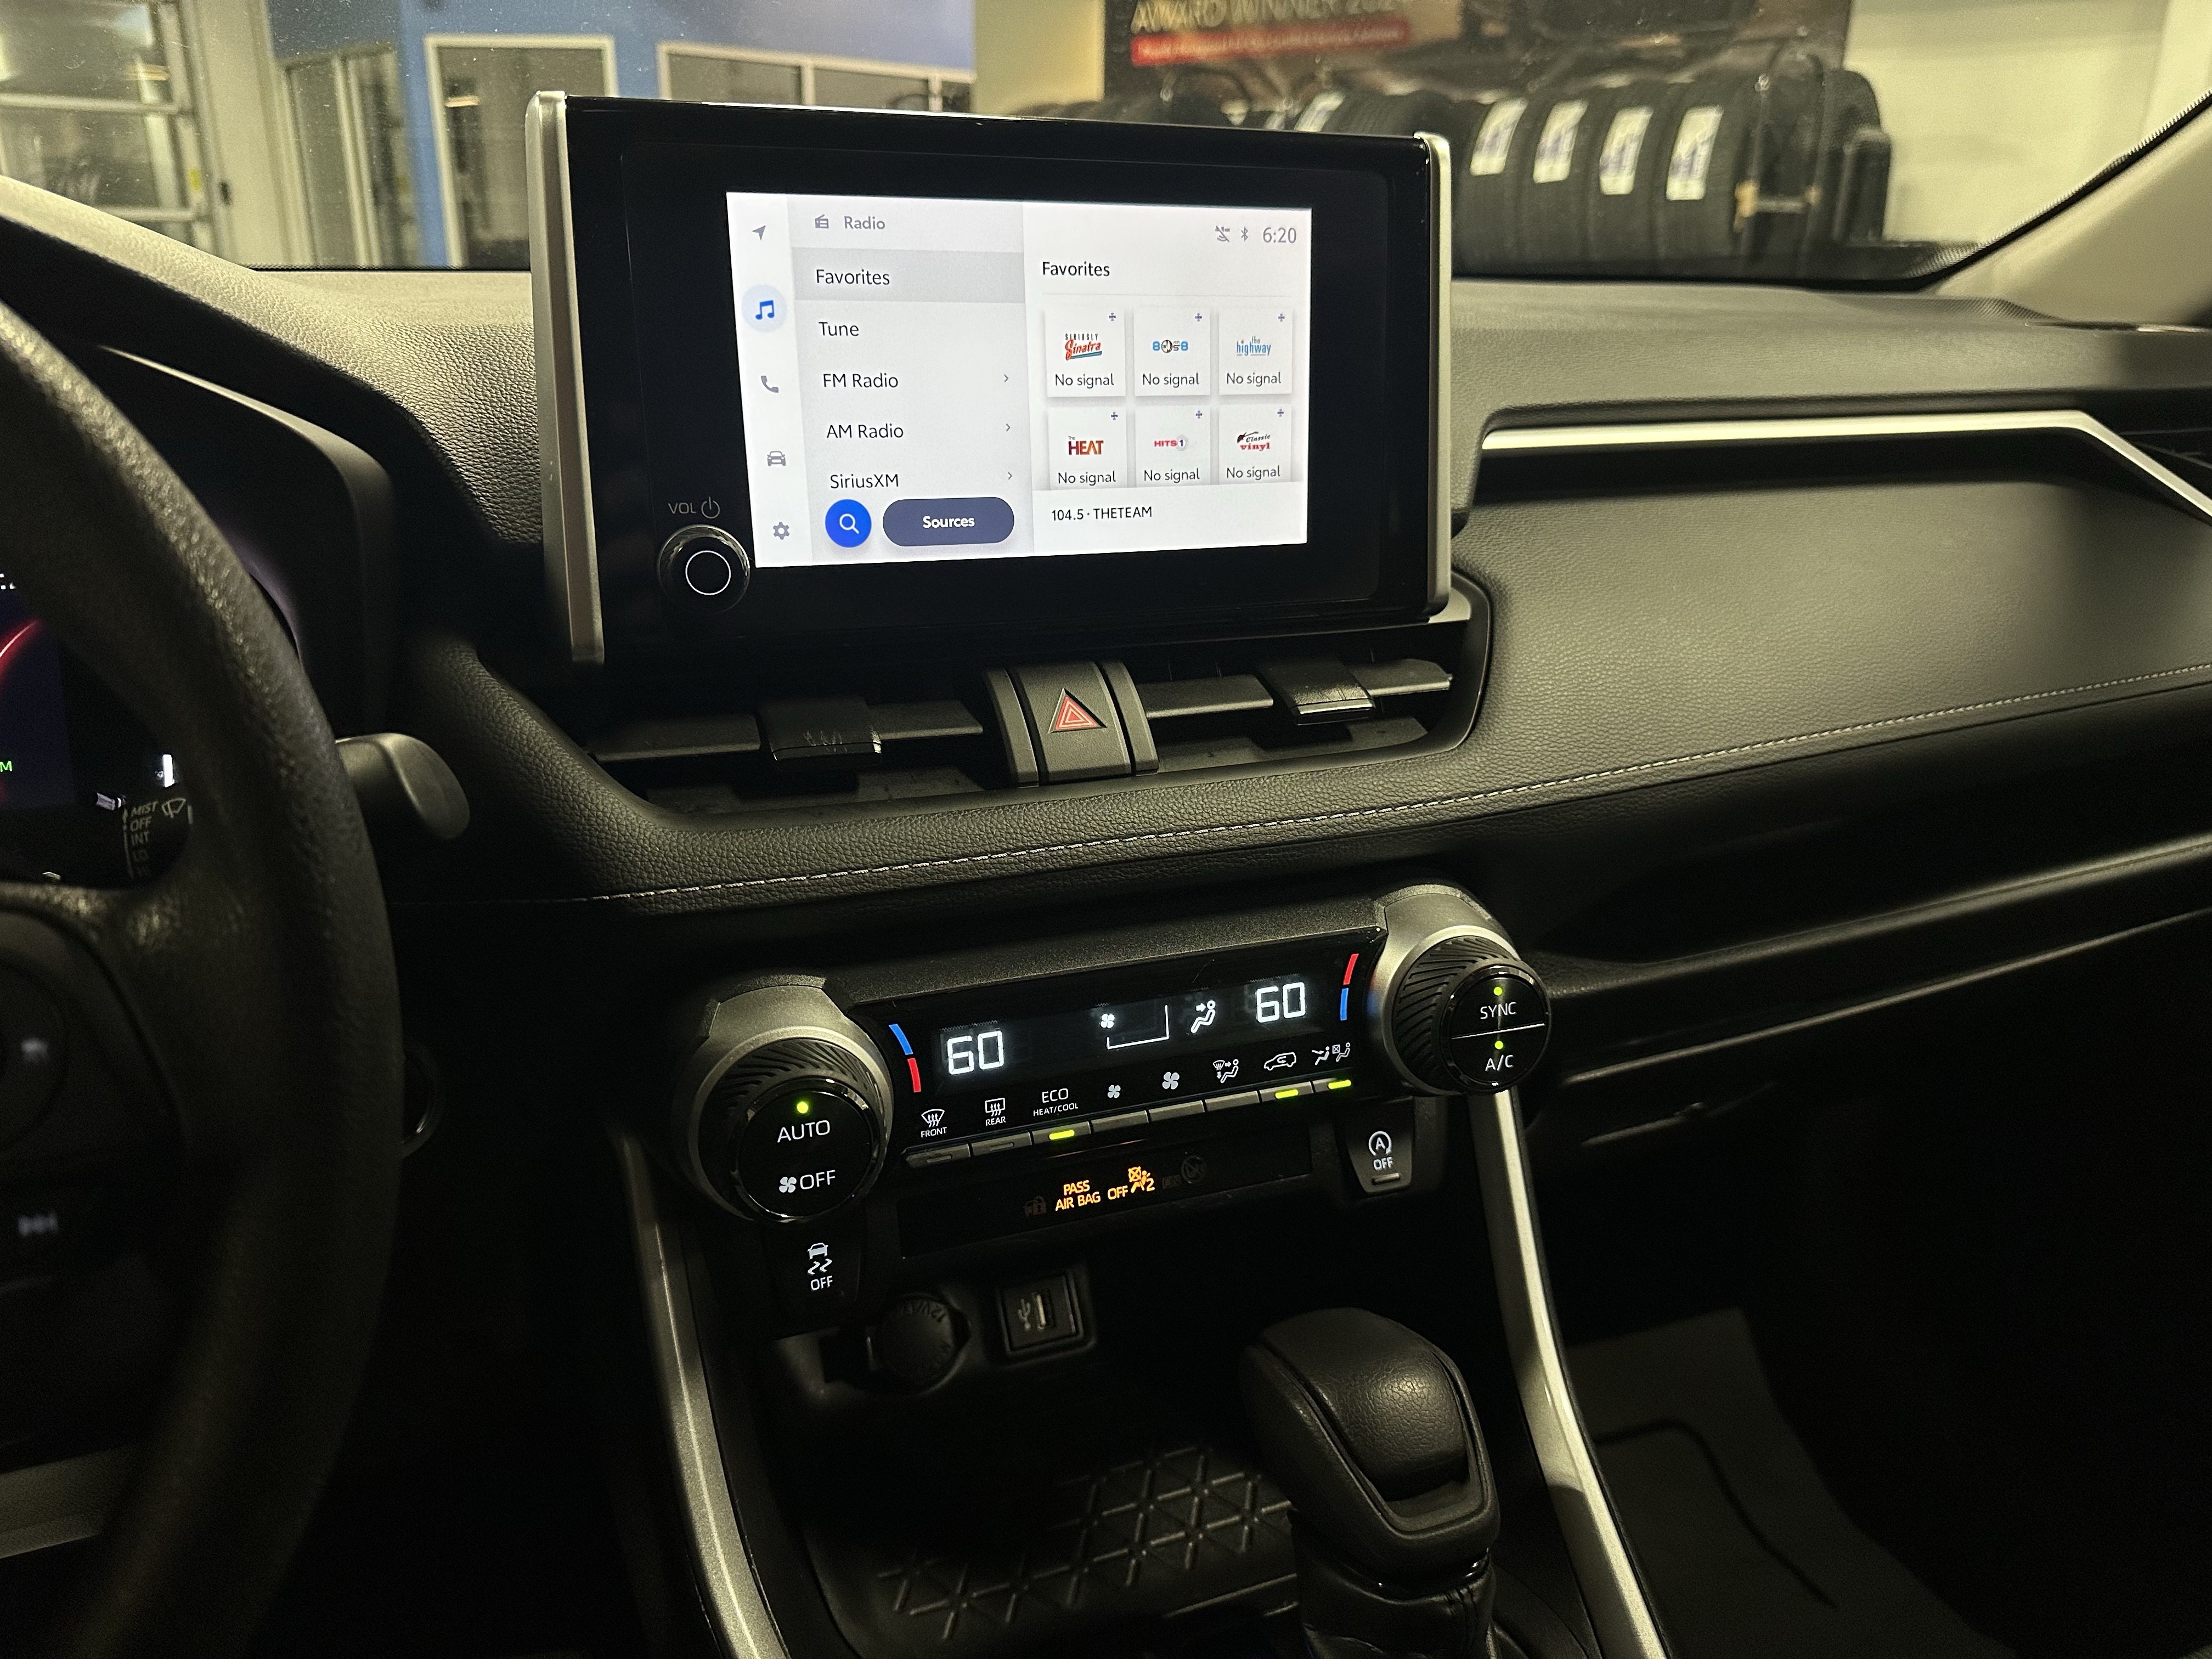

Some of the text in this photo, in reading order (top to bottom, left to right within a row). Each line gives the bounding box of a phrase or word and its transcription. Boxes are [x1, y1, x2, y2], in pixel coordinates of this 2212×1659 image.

[844, 216, 885, 229] Radio
[1263, 227, 1296, 244] 6:20
[1043, 261, 1110, 276] Favorites
[816, 269, 890, 285] Favorites
[819, 322, 859, 336] Tune
[1064, 340, 1101, 360] Sinatra
[1237, 341, 1271, 356] highway
[823, 373, 898, 387] FM Radio
[1056, 373, 1114, 389] No signal
[1143, 373, 1199, 388] No signal
[1227, 371, 1281, 387] No signal
[827, 424, 904, 438] AM Radio
[1068, 440, 1104, 455] HEAT
[1240, 442, 1270, 452] vinyl
[1058, 471, 1116, 486] No signal
[1144, 468, 1200, 483] No signal
[1227, 465, 1280, 481] No signal
[831, 474, 898, 488] SiriusXM
[668, 503, 696, 514] VOL
[1052, 506, 1152, 521] 104.5 THETEAM
[923, 516, 975, 528] Sources
[131, 802, 158, 817] MIST
[130, 816, 152, 832] OFF
[1256, 982, 1306, 1023] 60
[1480, 1002, 1516, 1019] SYNC
[947, 1030, 1005, 1075] 60
[1485, 1055, 1513, 1071] A/C
[1042, 1088, 1068, 1103] ECO
[1033, 1103, 1079, 1116] HEAT/COOL
[985, 1116, 1006, 1126] REAR
[777, 1120, 830, 1142] AUTO
[921, 1127, 947, 1137] FRONT
[1373, 1157, 1393, 1171] OFF
[800, 1170, 835, 1189] OFF
[1063, 1180, 1090, 1195] PASS
[1055, 1197, 1075, 1211] AIR
[1077, 1192, 1101, 1207] BAG
[1107, 1186, 1128, 1200] OFF
[810, 1276, 833, 1291] OFF
